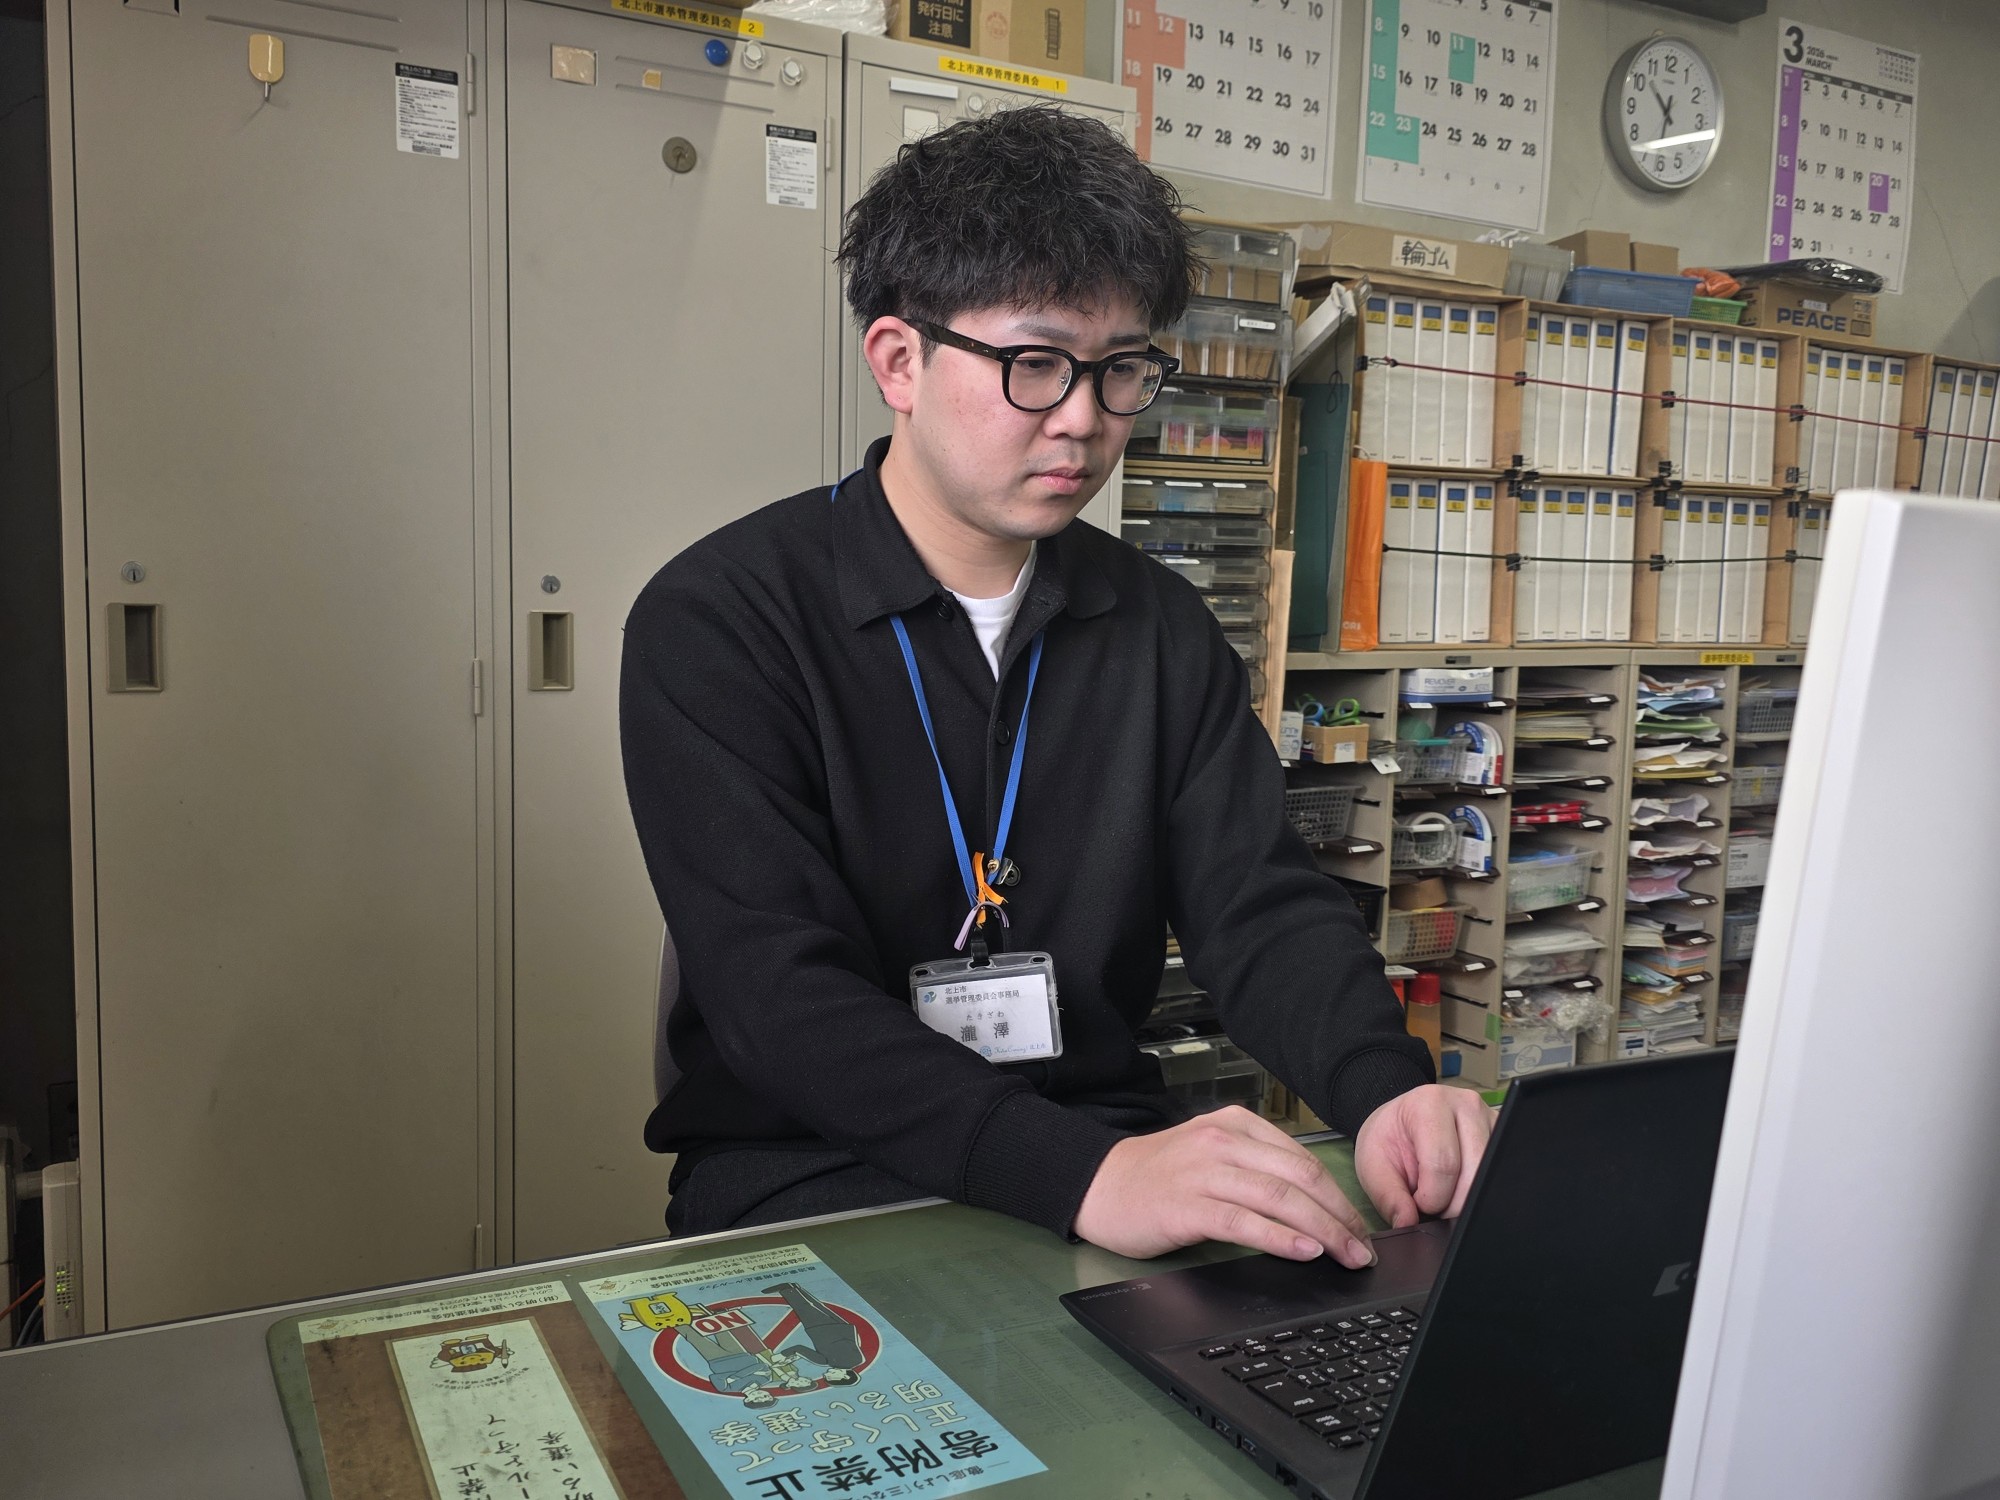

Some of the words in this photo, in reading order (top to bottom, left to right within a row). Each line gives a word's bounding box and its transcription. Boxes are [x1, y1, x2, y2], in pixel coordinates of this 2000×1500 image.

[619, 0, 732, 30] 北上市選挙管理委員会
[748, 22, 755, 33] 2
[917, 1, 965, 23] 発行日に
[1308, 2, 1324, 18] 10
[1504, 4, 1512, 18] 6
[1529, 11, 1537, 24] 7
[928, 20, 954, 39] 注意
[1126, 9, 1142, 25] 11
[1158, 16, 1174, 33] 12
[1189, 23, 1204, 40] 13
[1219, 30, 1234, 46] 14
[1249, 37, 1263, 53] 15
[1278, 44, 1292, 60] 16
[1306, 50, 1320, 66] 17
[1375, 17, 1383, 32] 8
[1401, 24, 1410, 38] 9
[1427, 30, 1441, 46] 10
[1452, 36, 1464, 50] 11
[1478, 42, 1490, 58] 12
[1502, 48, 1515, 62] 13
[1526, 54, 1540, 68] 14
[1784, 26, 1804, 64] 3
[947, 59, 1040, 86] 北上市選挙管理委員会
[1055, 80, 1060, 90] 1
[1648, 58, 1659, 76] 11
[1665, 55, 1678, 73] 12
[1684, 68, 1689, 84] 1
[1806, 58, 1832, 70] MARCH
[1126, 60, 1142, 76] 18
[1156, 67, 1172, 83] 19
[1187, 74, 1204, 90] 20
[1217, 80, 1232, 96] 21
[1246, 86, 1263, 102] 22
[1275, 93, 1292, 108] 23
[1304, 99, 1320, 114] 24
[1372, 64, 1386, 80] 15
[1400, 70, 1412, 86] 16
[1424, 76, 1438, 91] 17
[1450, 82, 1462, 97] 18
[1476, 88, 1488, 103] 19
[1500, 94, 1514, 108] 20
[1524, 99, 1537, 113] 21
[1633, 72, 1646, 91] 10
[1627, 97, 1636, 114] 9
[1691, 87, 1701, 104] 2
[1804, 80, 1810, 92] 2
[1822, 85, 1830, 96] 3
[1841, 90, 1848, 100] 4
[1860, 94, 1866, 106] 5
[1877, 99, 1884, 110] 6
[1895, 104, 1902, 114] 7
[1370, 111, 1386, 126] 22
[1396, 117, 1412, 132] 23
[1422, 122, 1436, 137] 24
[1448, 128, 1462, 142] 25
[1472, 133, 1488, 148] 26
[1498, 138, 1512, 152] 27
[1522, 142, 1536, 157] 28
[1630, 123, 1639, 141] 8
[1695, 113, 1703, 130] 3
[1155, 116, 1173, 133] 26
[1186, 123, 1202, 138] 27
[1215, 129, 1232, 145] 28
[1244, 135, 1262, 150] 29
[1272, 140, 1290, 156] 30
[1300, 146, 1316, 162] 31
[1801, 120, 1808, 130] 9
[1820, 124, 1830, 136] 10
[1839, 128, 1848, 140] 11
[1856, 132, 1866, 144] 12
[1874, 137, 1884, 149] 13
[1892, 141, 1902, 154] 14
[1778, 155, 1789, 168] 15
[1798, 159, 1808, 172] 16
[1816, 163, 1826, 175] 17
[1835, 167, 1844, 180] 18
[1853, 171, 1864, 183] 19
[1871, 175, 1883, 187] 20
[1890, 178, 1901, 190] 21
[1775, 195, 1788, 208] 22
[1794, 199, 1806, 211] 23
[1813, 202, 1824, 214] 24
[1832, 206, 1843, 218] 25
[1850, 210, 1862, 222] 26
[1870, 213, 1882, 224] 27
[1889, 216, 1900, 228] 28
[1401, 240, 1450, 270] 輪ゴム
[1772, 234, 1785, 246] 29
[1792, 238, 1804, 250] 30
[1810, 241, 1822, 252] 31
[1776, 307, 1847, 332] PEACE
[944, 985, 967, 995] 北上市
[966, 1011, 1005, 1021] たきざわ
[1080, 1287, 1130, 1302] dynabook
[695, 1311, 748, 1333] NO
[709, 1379, 943, 1447] 明るい選挙
[1293, 1398, 1315, 1406] Enter
[730, 1400, 968, 1473] 正しく守って
[746, 1429, 1000, 1500] 寄附禁止
[450, 1463, 492, 1500] 禁止
[848, 1465, 984, 1500] 徹底しよう「三ない
